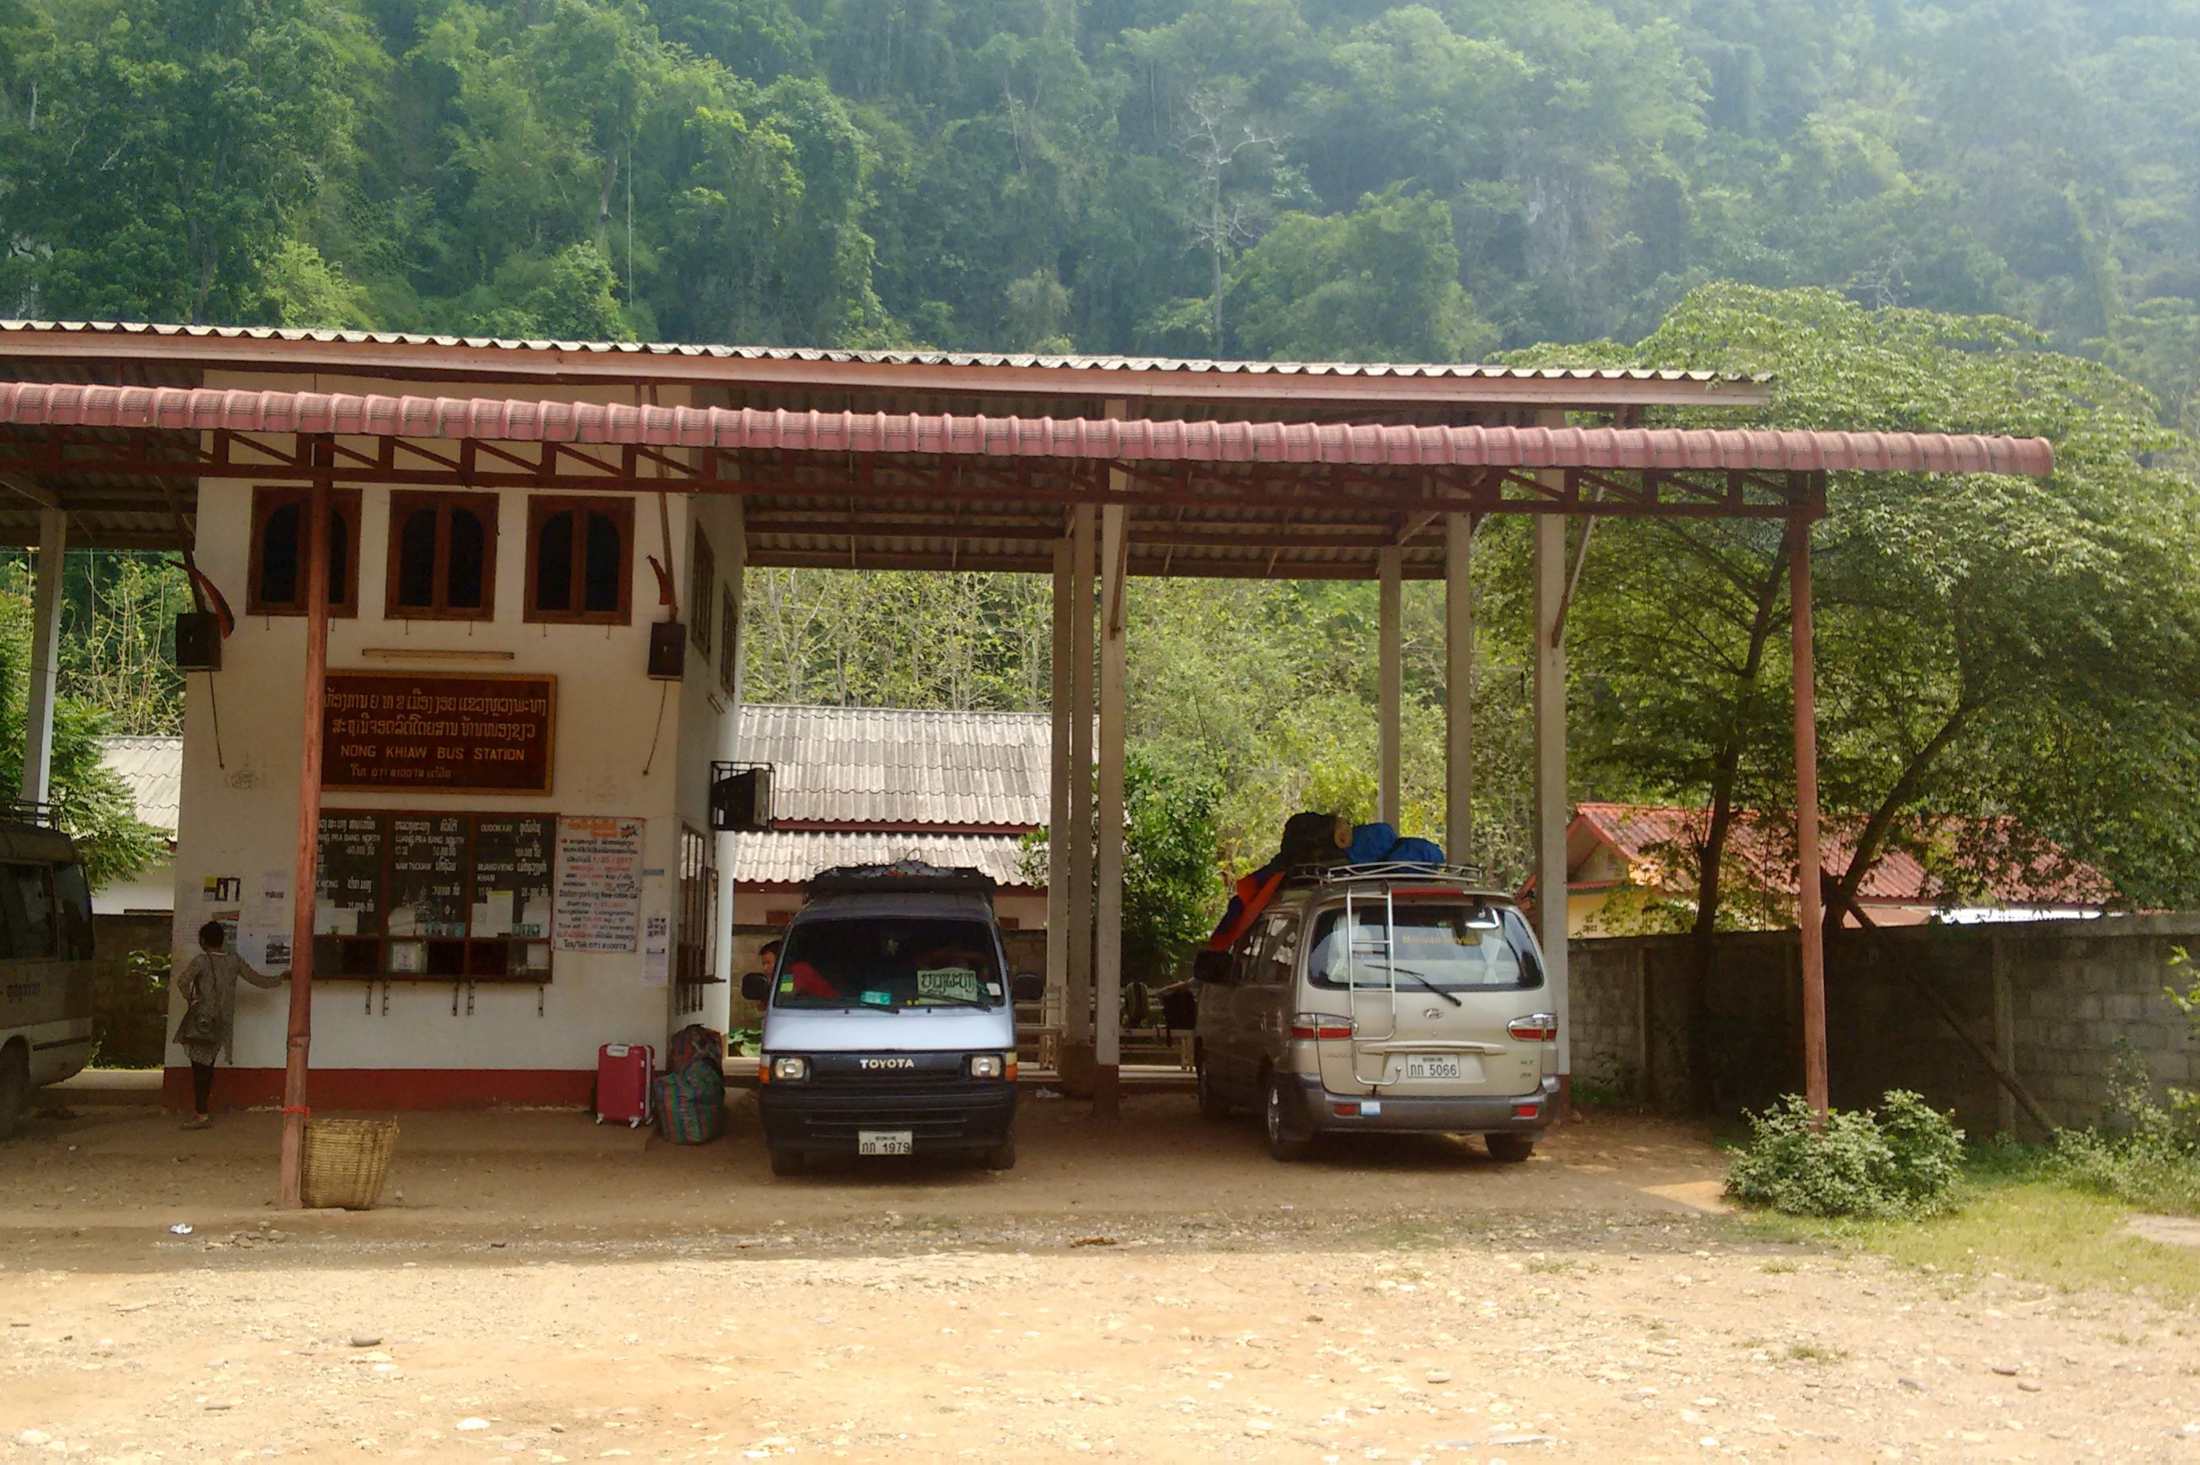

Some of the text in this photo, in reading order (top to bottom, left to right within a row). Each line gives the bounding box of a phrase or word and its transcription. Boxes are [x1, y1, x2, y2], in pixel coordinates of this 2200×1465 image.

[340, 744, 525, 761] NONG KHIAW BUS STATION
[859, 1058, 914, 1070] TOYOTA
[1429, 1063, 1457, 1076] 5066
